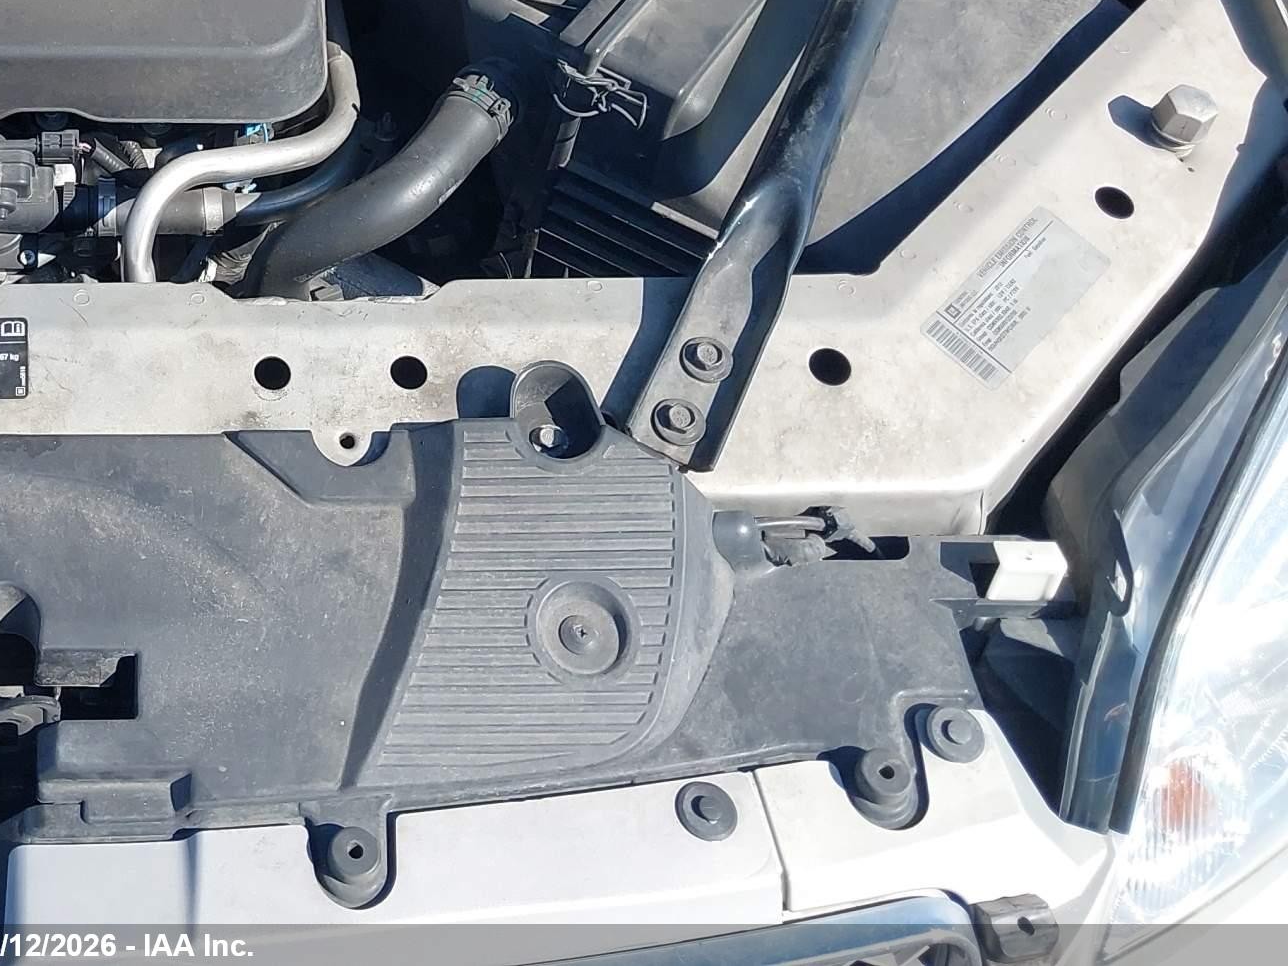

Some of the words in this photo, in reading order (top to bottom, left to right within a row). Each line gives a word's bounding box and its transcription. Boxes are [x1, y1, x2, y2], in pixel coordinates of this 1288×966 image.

[977, 258, 997, 278] VEHICLE
[1016, 217, 1038, 239] CONTROL
[999, 236, 1030, 268] INFORMATION
[9, 353, 20, 362] kg
